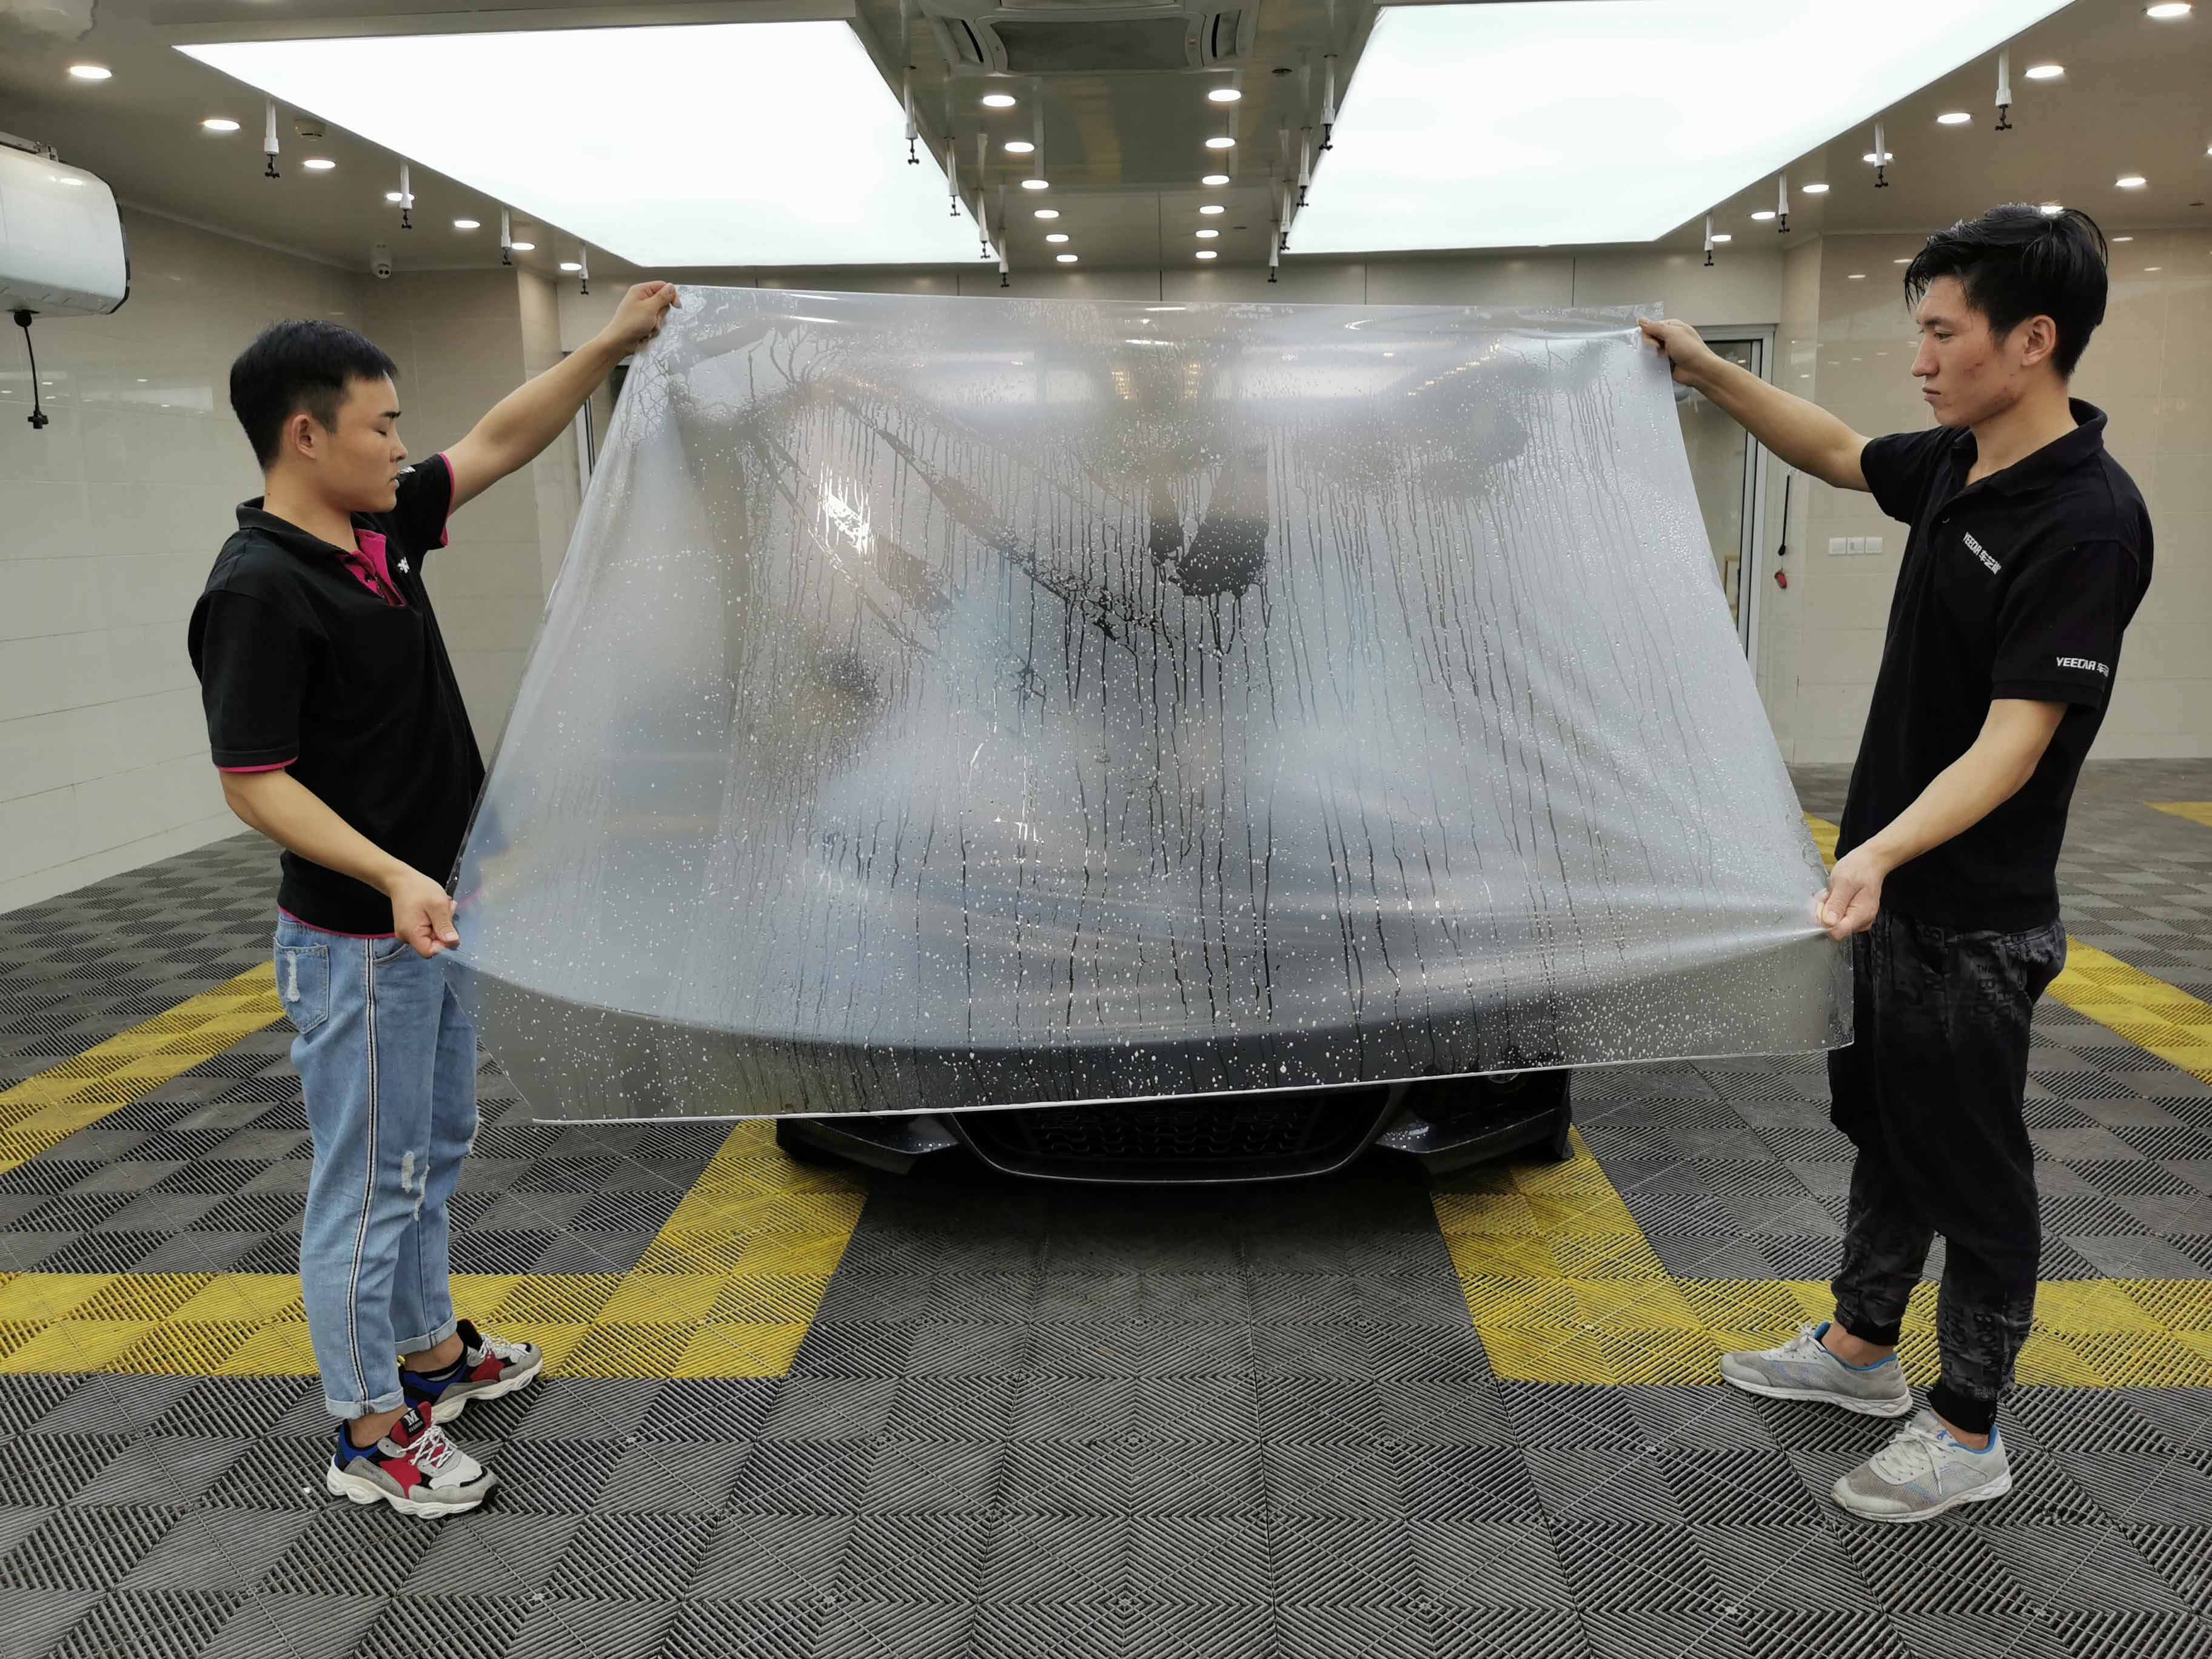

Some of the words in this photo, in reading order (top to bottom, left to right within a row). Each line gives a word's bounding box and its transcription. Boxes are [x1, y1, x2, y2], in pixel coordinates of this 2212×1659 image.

[1963, 532, 1982, 555] YEECAR
[2056, 657, 2096, 671] YEECAR
[403, 1410, 420, 1426] M
